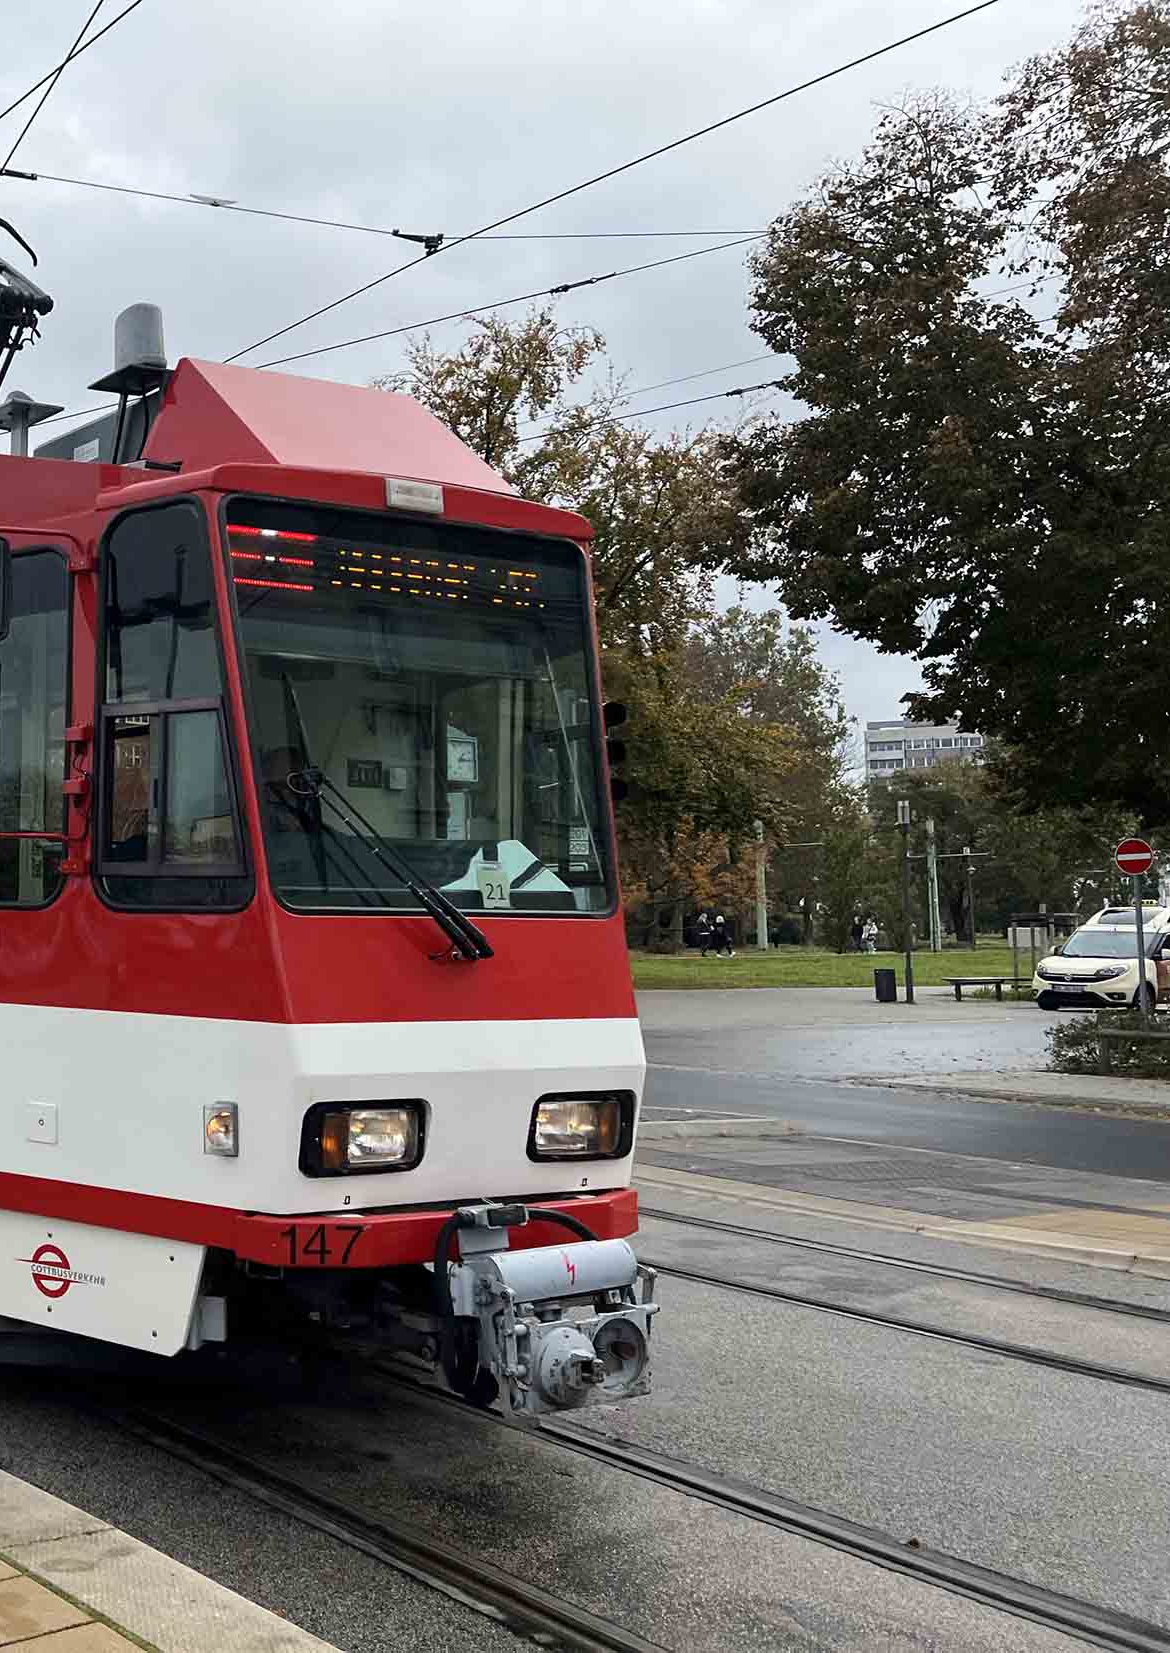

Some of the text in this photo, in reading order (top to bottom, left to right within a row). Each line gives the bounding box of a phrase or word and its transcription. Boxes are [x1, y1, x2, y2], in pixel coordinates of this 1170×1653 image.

[485, 883, 507, 901] 21
[280, 1223, 365, 1265] 147
[30, 1263, 106, 1287] COTTBUSVERKEHR
